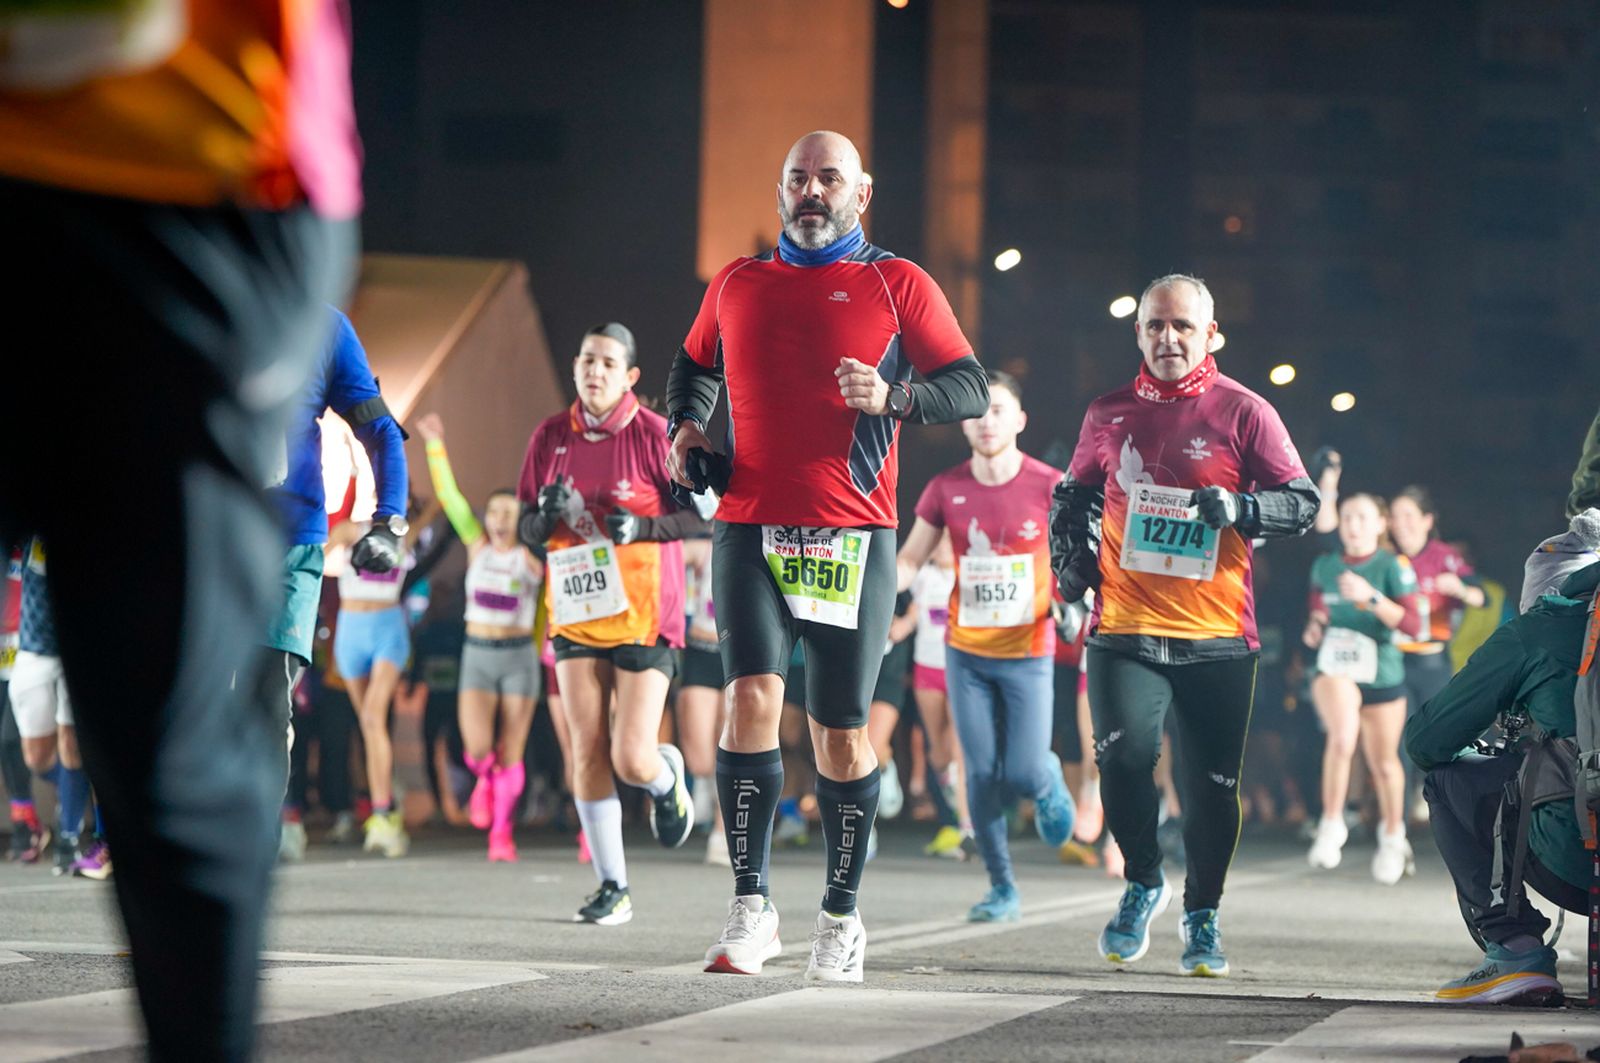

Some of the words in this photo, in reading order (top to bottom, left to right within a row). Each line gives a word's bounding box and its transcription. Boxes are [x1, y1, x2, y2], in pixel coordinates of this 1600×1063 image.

[1138, 504, 1155, 514] SAN
[1150, 495, 1177, 506] NOCHE
[787, 535, 818, 545] NOCHE
[821, 537, 833, 546] DE
[1141, 516, 1205, 549] 12774
[775, 544, 796, 556] SAN
[563, 570, 607, 596] 4029
[782, 557, 849, 593] 5650
[974, 582, 1017, 602] 1552
[1464, 963, 1498, 982] HOKA
